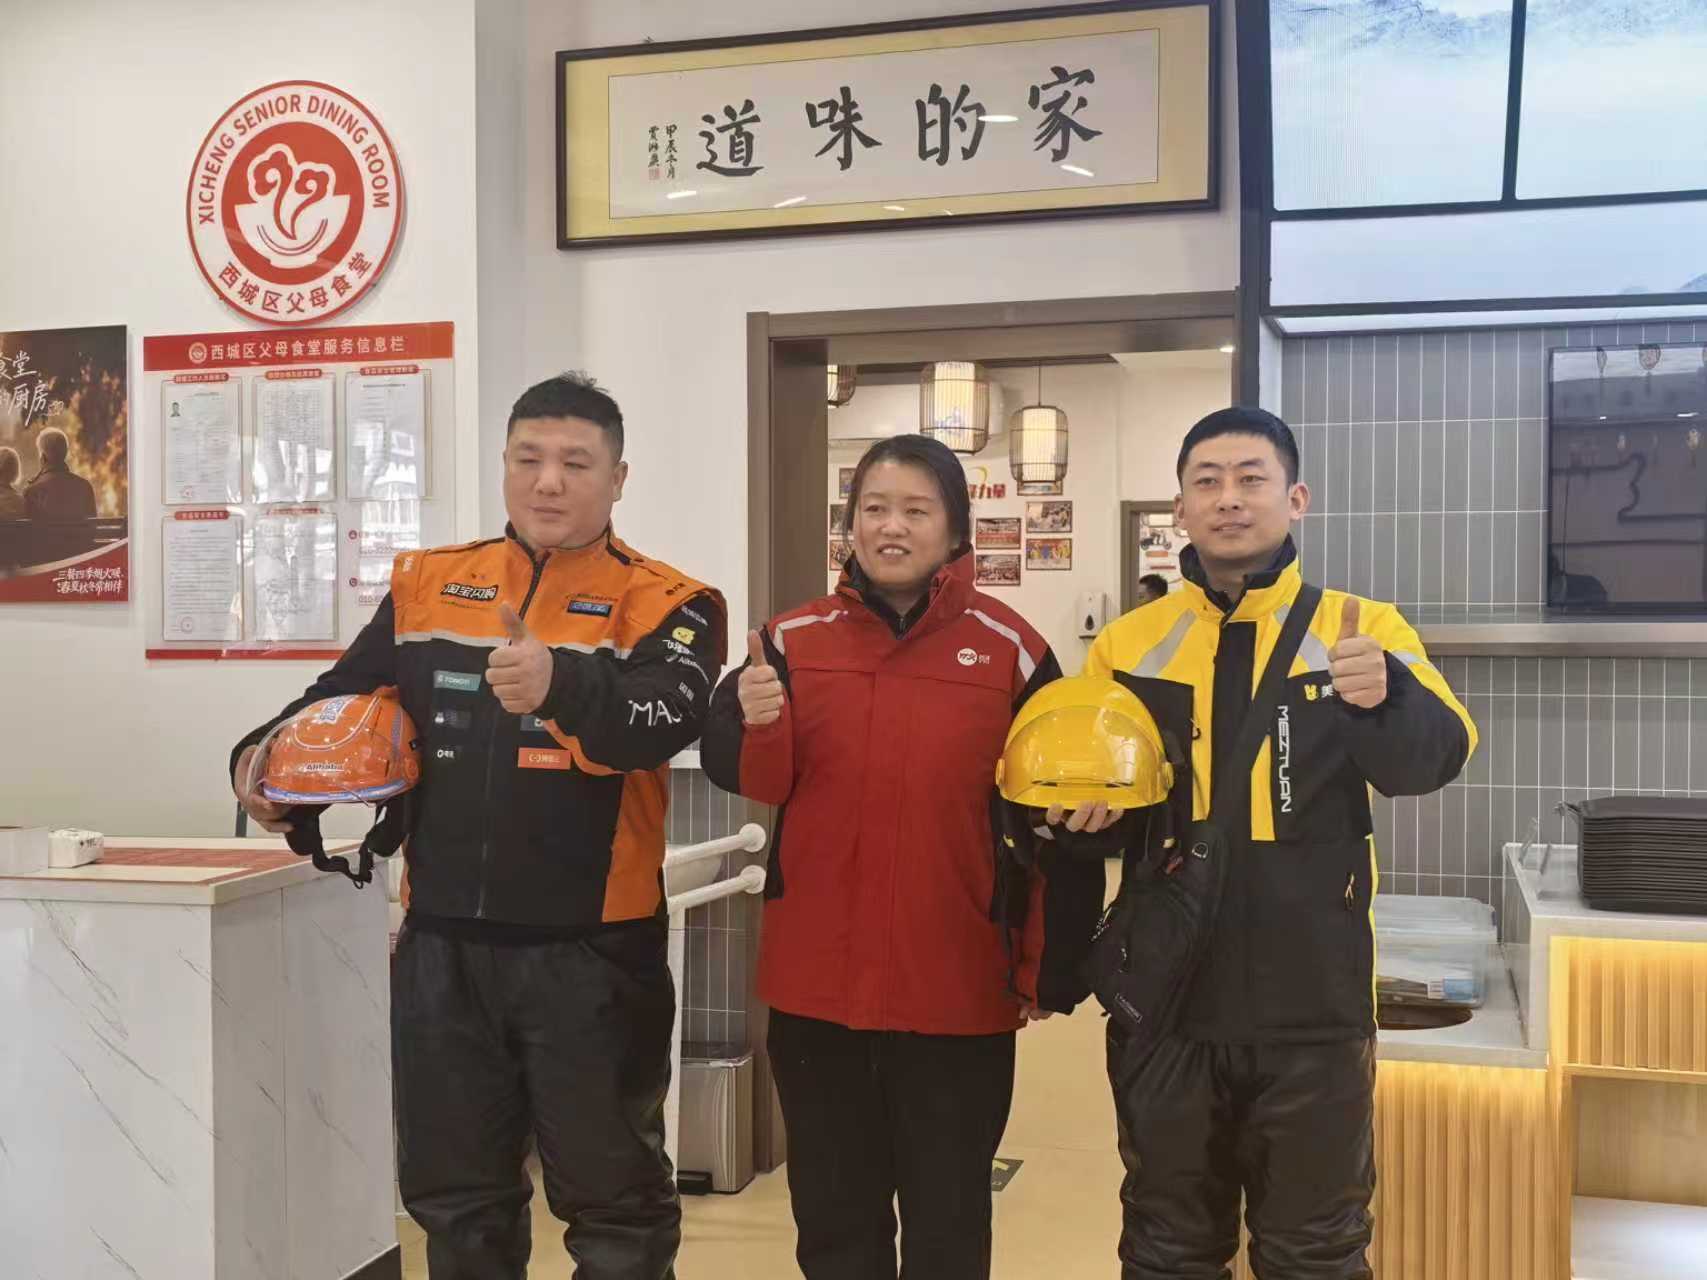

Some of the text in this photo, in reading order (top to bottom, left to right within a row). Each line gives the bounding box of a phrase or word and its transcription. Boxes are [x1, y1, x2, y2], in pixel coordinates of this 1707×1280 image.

[198, 94, 390, 226] XICHENG SENIOR DINING ROOM
[218, 251, 373, 314] 西城区父母食堂
[210, 335, 405, 361] 西城区父母食堂服务信息栏
